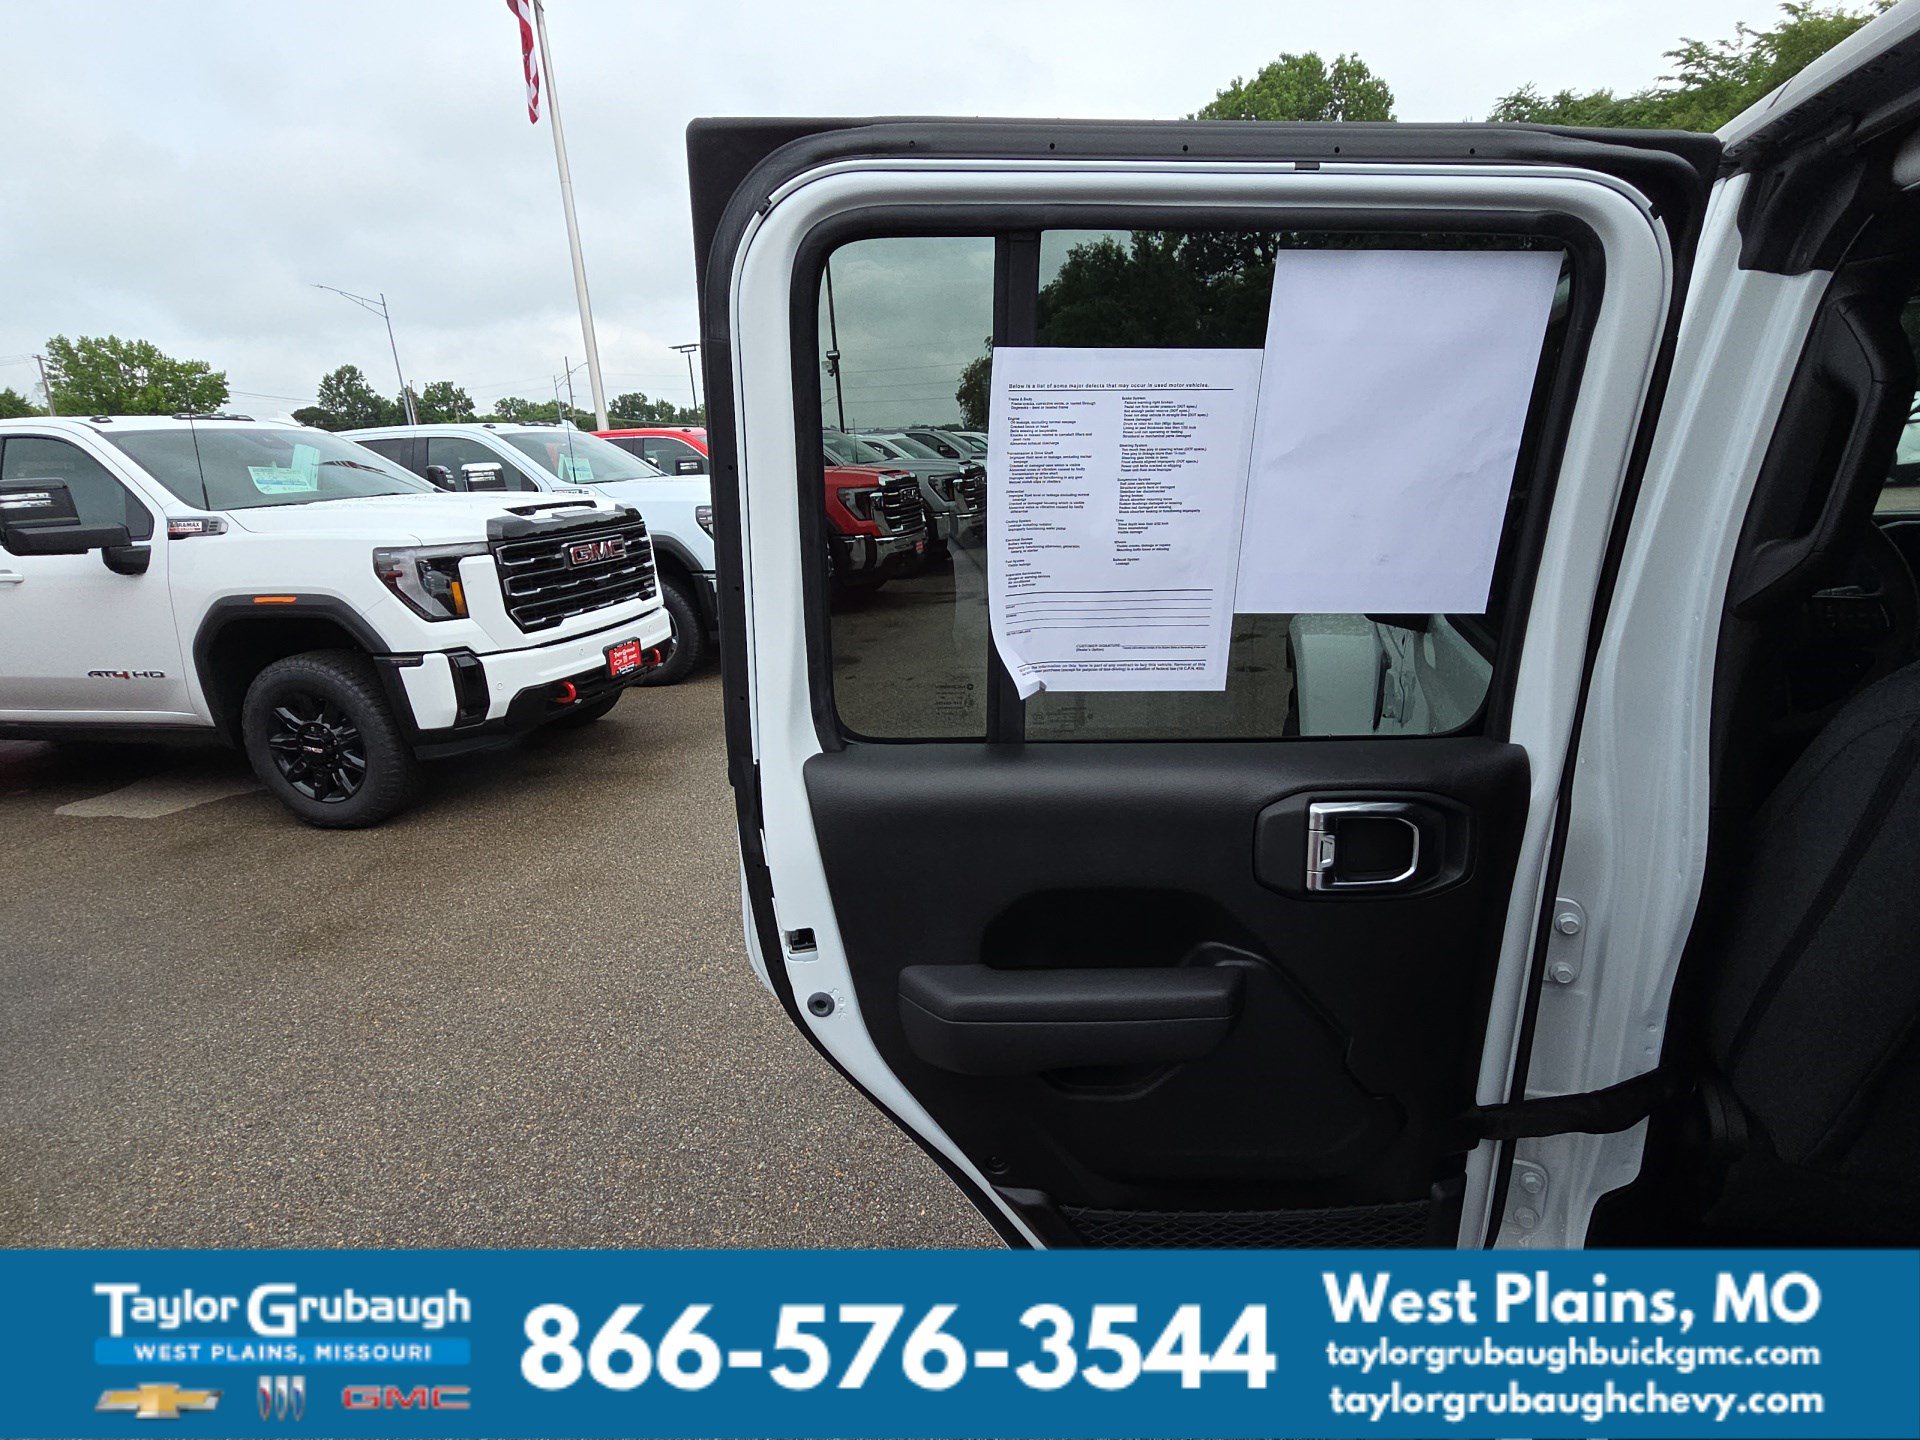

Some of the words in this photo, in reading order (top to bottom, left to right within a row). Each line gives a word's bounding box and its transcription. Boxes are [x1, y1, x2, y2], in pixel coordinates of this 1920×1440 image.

[569, 540, 625, 565] GMC
[88, 670, 130, 680] AT4
[132, 670, 166, 679] HD
